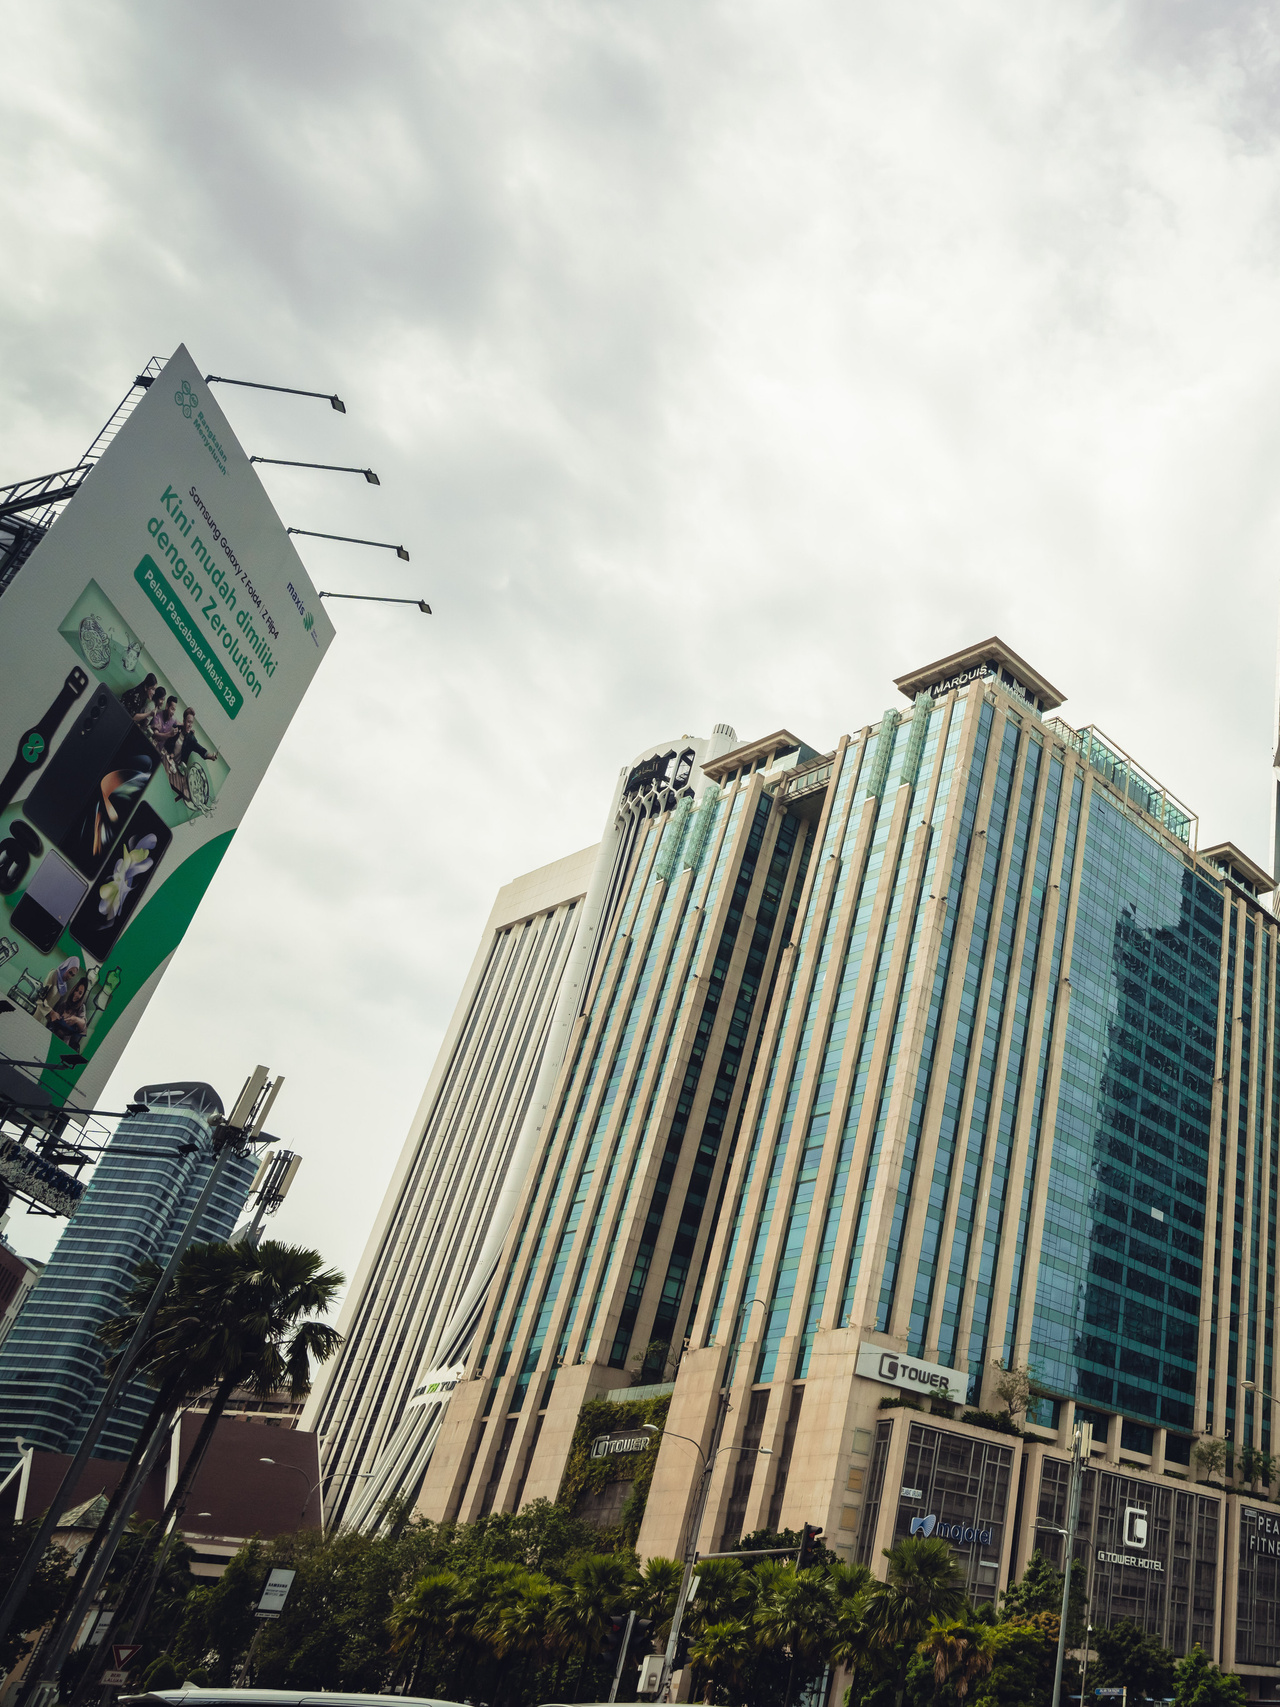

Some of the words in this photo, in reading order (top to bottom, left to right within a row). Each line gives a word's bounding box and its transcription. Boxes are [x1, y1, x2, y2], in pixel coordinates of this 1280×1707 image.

[193, 418, 227, 476] Menyeluruh
[198, 411, 227, 462] Rangkaian
[160, 484, 195, 538] Kini
[190, 536, 237, 611] mudah
[236, 610, 278, 678] dimiliki
[189, 486, 222, 541] Samsung
[220, 537, 243, 576] Galaxy
[240, 573, 248, 583] Z
[245, 580, 262, 608] Fold4
[261, 609, 269, 619] Z
[265, 616, 280, 639] Flip4
[147, 517, 203, 602] dengan
[201, 595, 262, 698] Zerolution
[286, 582, 305, 615] maxis
[144, 569, 168, 605] Pelan
[166, 602, 206, 661] Pascabayar
[204, 658, 224, 690] Maxis
[222, 687, 236, 706] 128
[933, 665, 988, 696] MARQUIS
[900, 1364, 950, 1390] TOWER
[609, 1437, 650, 1454] TOWER
[936, 1521, 993, 1545] majorel
[1106, 1552, 1136, 1567] TOWER
[1138, 1558, 1165, 1571] HOTEL
